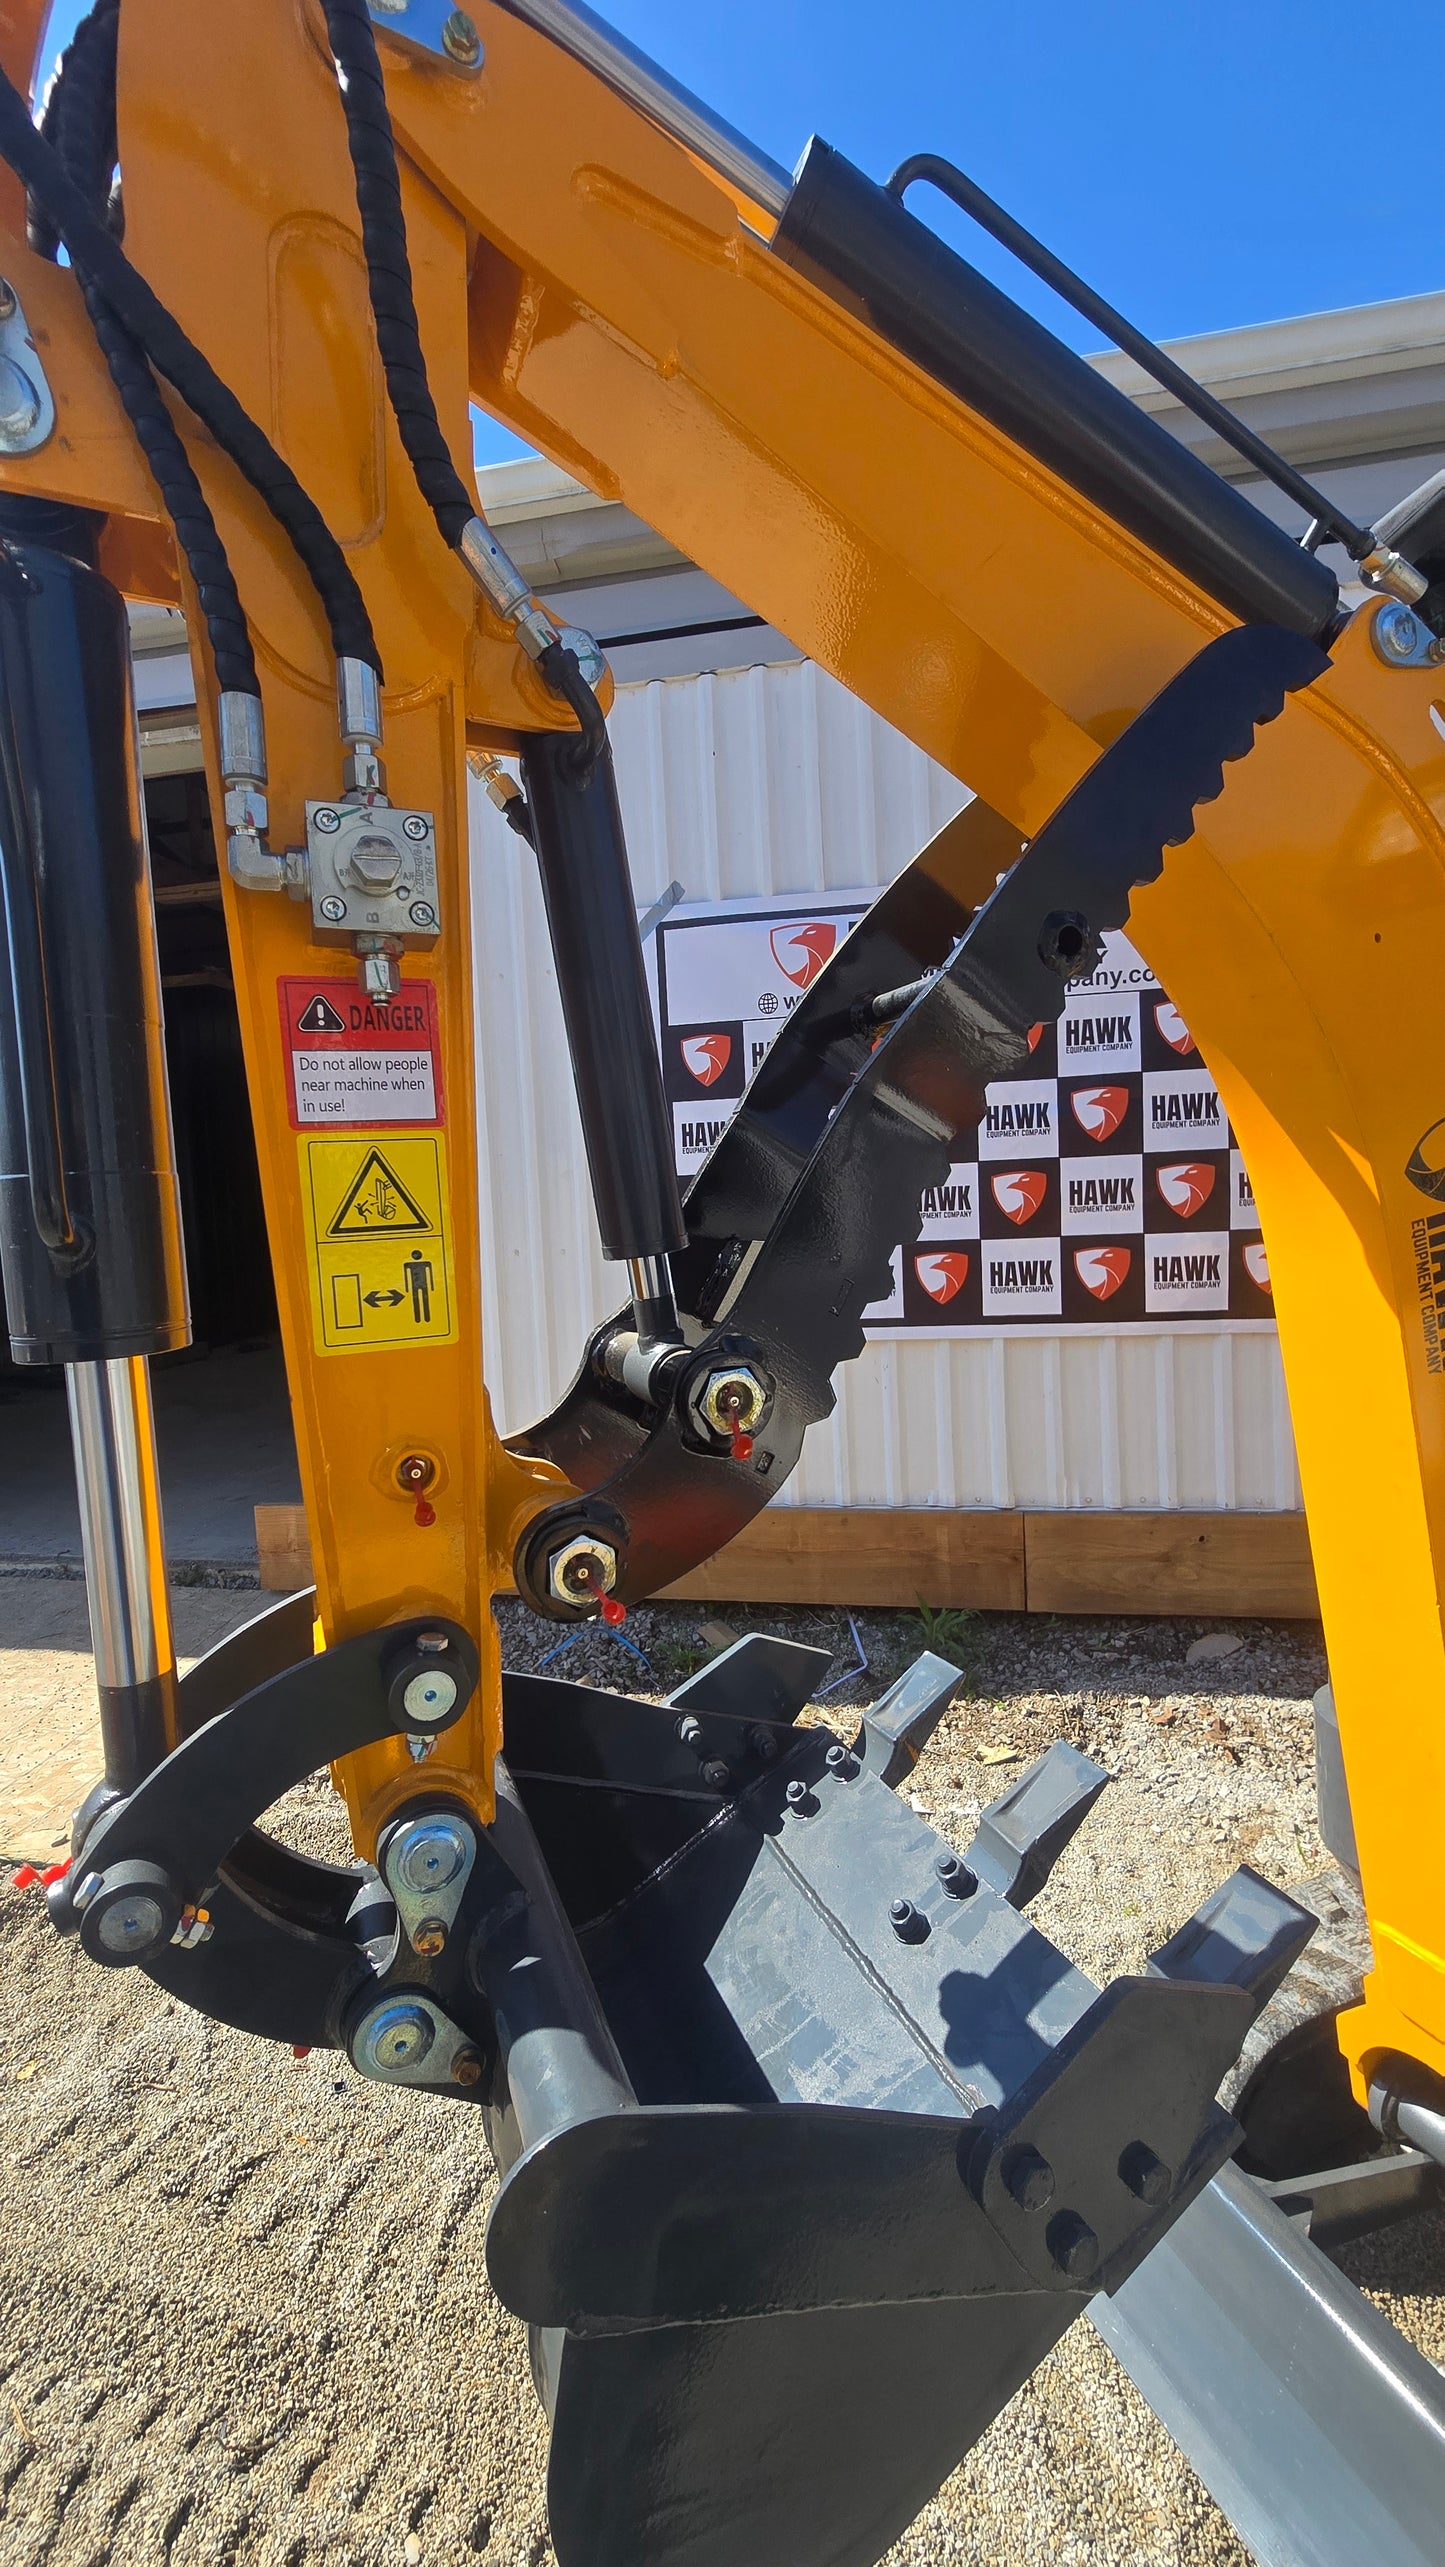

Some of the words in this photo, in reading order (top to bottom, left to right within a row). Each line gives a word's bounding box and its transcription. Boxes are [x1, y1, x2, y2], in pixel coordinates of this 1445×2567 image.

[366, 911, 379, 923] B
[349, 1005, 427, 1032] DANGER
[1066, 1016, 1132, 1046] HAWK
[1066, 1045, 1100, 1054] EQUIPMENT
[1102, 1042, 1133, 1052] COMPANY
[299, 1057, 319, 1071] Do
[323, 1058, 345, 1070] not
[349, 1056, 382, 1070] allow
[386, 1056, 428, 1074] people
[302, 1080, 330, 1091] near
[334, 1077, 388, 1091] machine
[391, 1077, 425, 1090] when
[303, 1099, 316, 1112] in
[319, 1099, 345, 1112] use!
[986, 1102, 1050, 1131] HAWK
[1152, 1092, 1219, 1121] HAWK
[681, 1121, 726, 1147] HAW
[986, 1130, 1020, 1138] EQUIPMENT
[1021, 1128, 1051, 1136] COMPANY
[1152, 1121, 1187, 1129] EQUIPMENT
[1189, 1119, 1220, 1127] COMPANY
[920, 1185, 972, 1211] AWK
[1069, 1178, 1135, 1205] HAWK
[943, 1210, 972, 1218] COMPANY
[1105, 1204, 1135, 1212] COMPANY
[1153, 1255, 1220, 1282] HAWK
[1411, 1218, 1434, 1301] EQUIPMENT
[990, 1260, 1053, 1286] HAWK
[990, 1286, 1023, 1294] EQUIPMENT
[1025, 1284, 1054, 1292] COMPANY
[1153, 1282, 1188, 1290] EQUIPMENT
[1190, 1280, 1221, 1288] COMPANY
[1420, 1303, 1443, 1374] COMPANY
